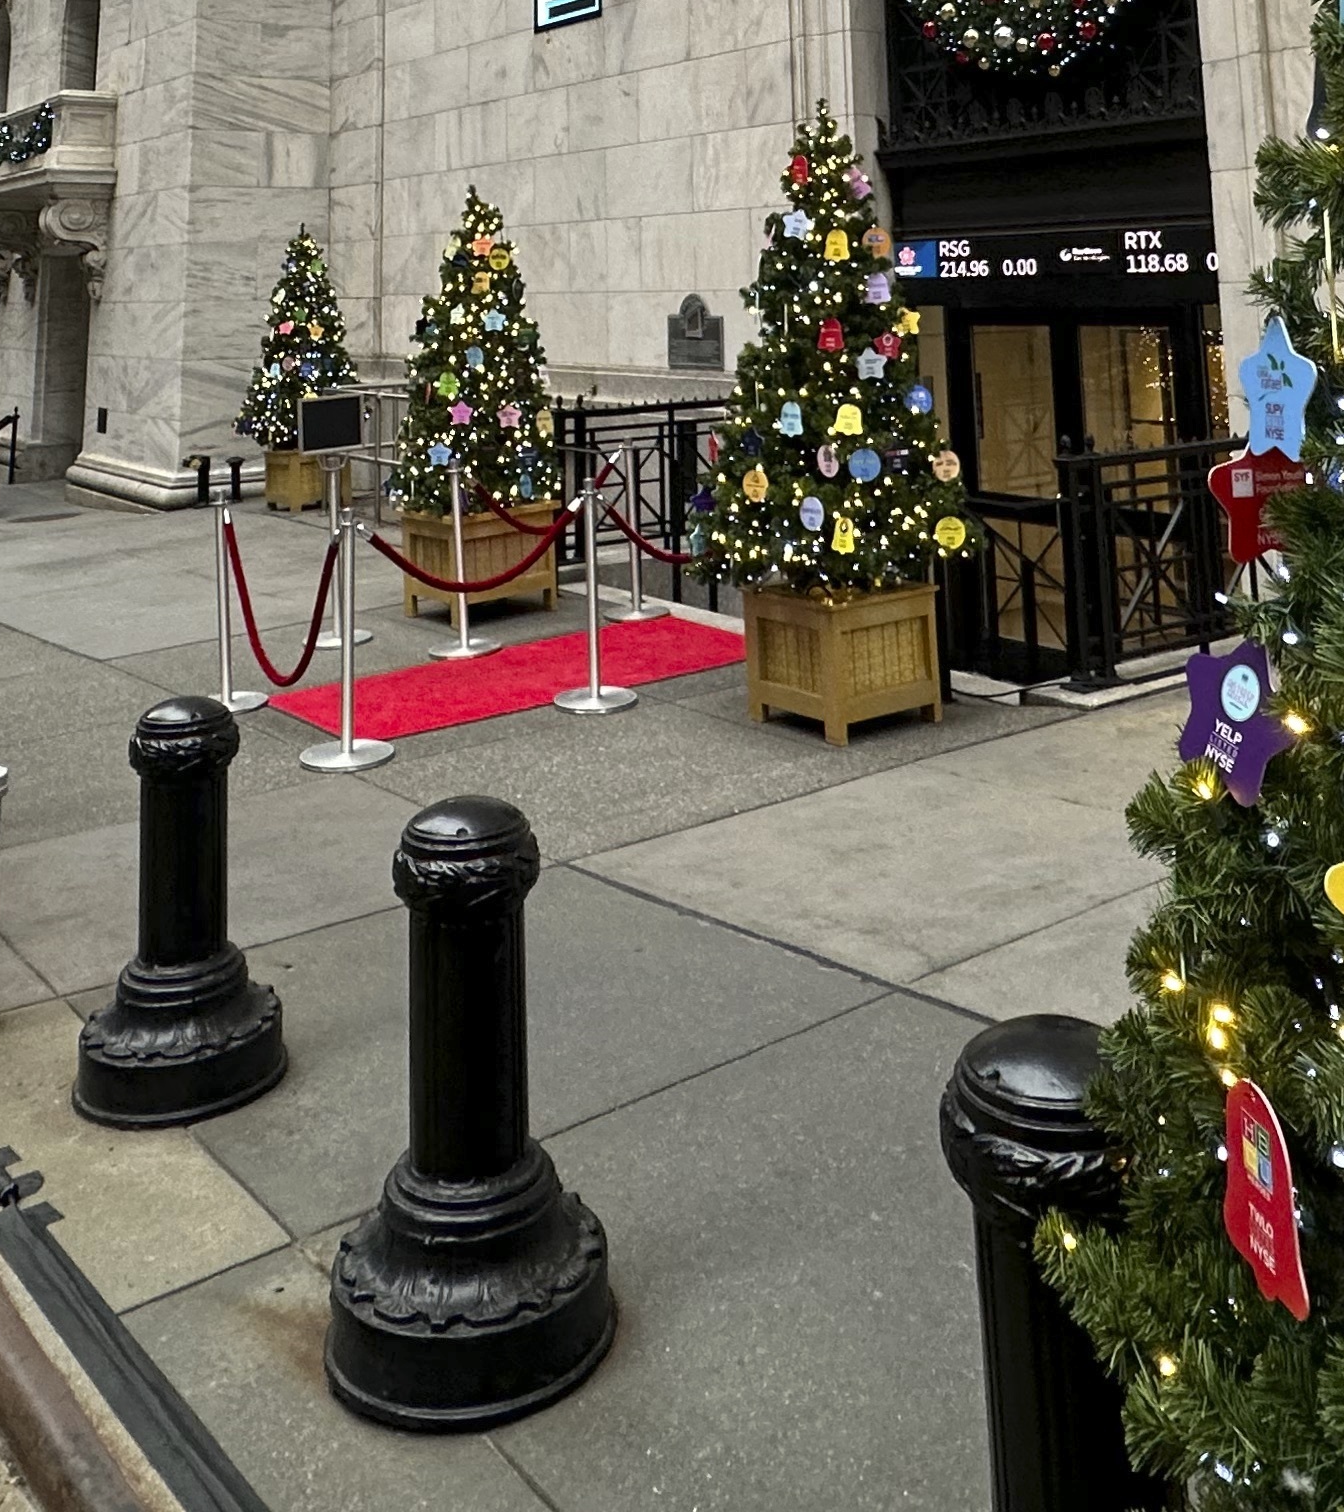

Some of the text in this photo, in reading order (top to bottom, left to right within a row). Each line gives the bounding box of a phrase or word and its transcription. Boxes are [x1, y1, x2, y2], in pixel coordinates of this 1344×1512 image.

[939, 240, 971, 257] RSG
[1124, 231, 1163, 250] RTX
[940, 260, 990, 278] 214.96
[1002, 259, 1038, 276] 0.00
[1126, 253, 1189, 273] 118.68
[1265, 428, 1284, 441] NYSE
[1234, 472, 1250, 482] SYF
[1215, 718, 1243, 745] YELP
[1204, 744, 1235, 774] NYSE
